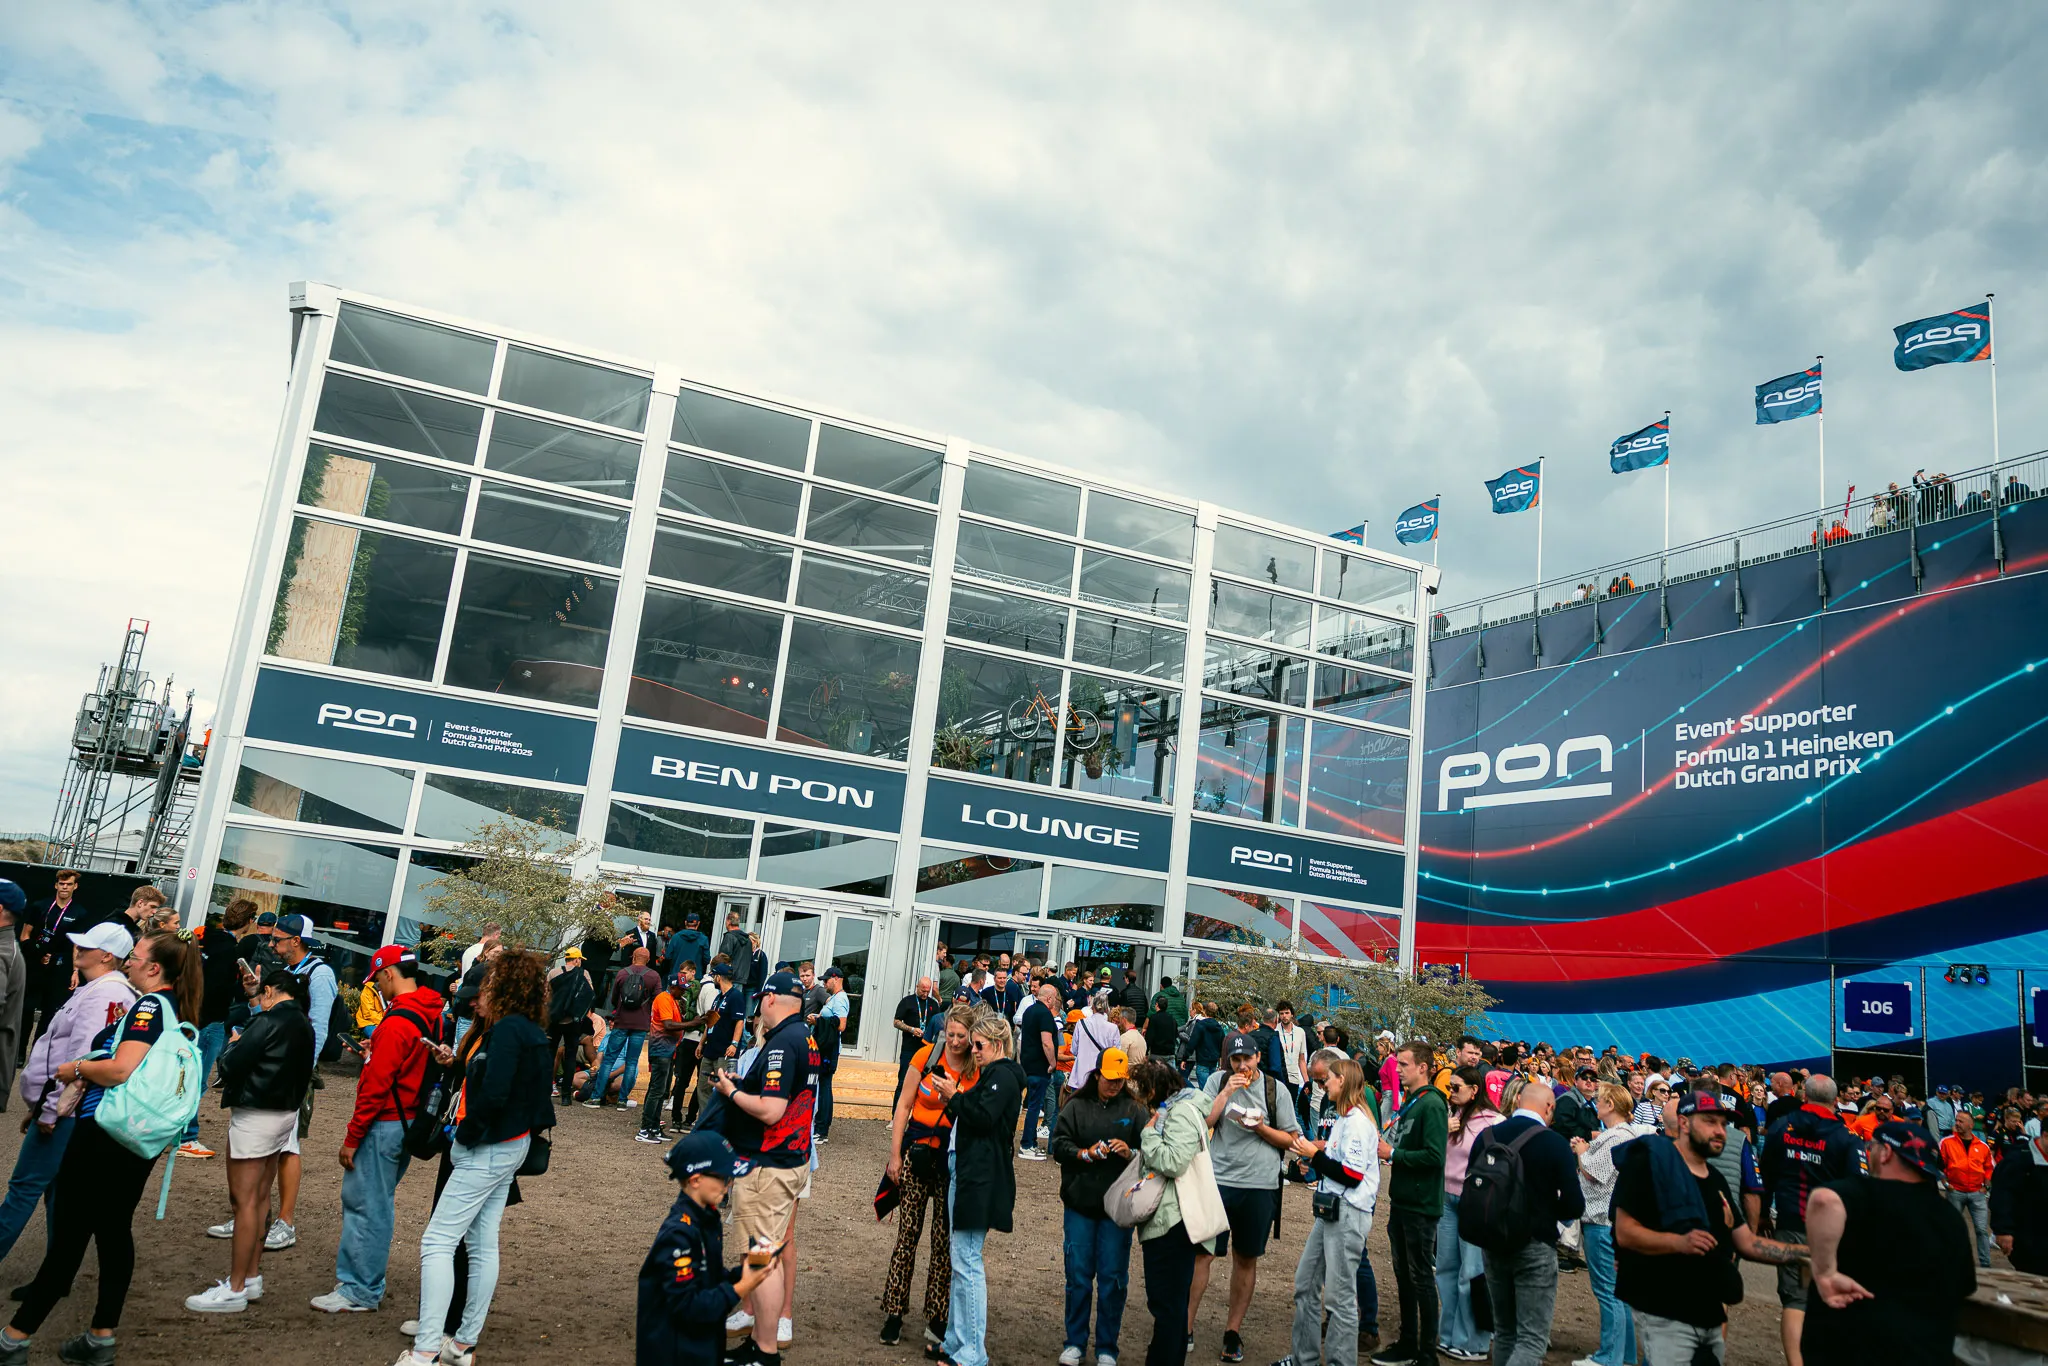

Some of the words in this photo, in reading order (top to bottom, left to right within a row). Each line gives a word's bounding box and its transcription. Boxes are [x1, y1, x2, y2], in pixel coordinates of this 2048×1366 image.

[317, 702, 418, 731] pon
[1675, 717, 1736, 741] Event
[1740, 704, 1857, 734] Supporter
[442, 730, 468, 742] Formula
[477, 735, 483, 743] 1
[484, 736, 523, 749] Heineken
[444, 721, 470, 731] Event
[470, 726, 513, 739] Supporter
[441, 737, 467, 747] Dutch
[467, 741, 494, 751] Grand
[494, 744, 511, 754] Prix
[511, 747, 534, 757] 2025
[1675, 743, 1760, 768] Formula
[1764, 740, 1777, 759] 1
[1781, 730, 1894, 758] Heineken
[650, 754, 759, 791] BEN
[768, 773, 876, 810] PON
[1437, 734, 1613, 812] pon
[1675, 767, 1736, 789] Dutch
[1740, 760, 1809, 784] Grand
[1814, 754, 1862, 778] Prix
[961, 803, 1141, 851] LOUNGE
[1230, 845, 1293, 867] pon
[1309, 858, 1326, 867] Event
[1326, 861, 1353, 871] Supporter
[1309, 865, 1331, 874] Formula
[1335, 869, 1361, 879] Heineken
[1309, 870, 1326, 879] Dutch
[1325, 873, 1343, 881] Grand
[1862, 1000, 1894, 1015] 106
